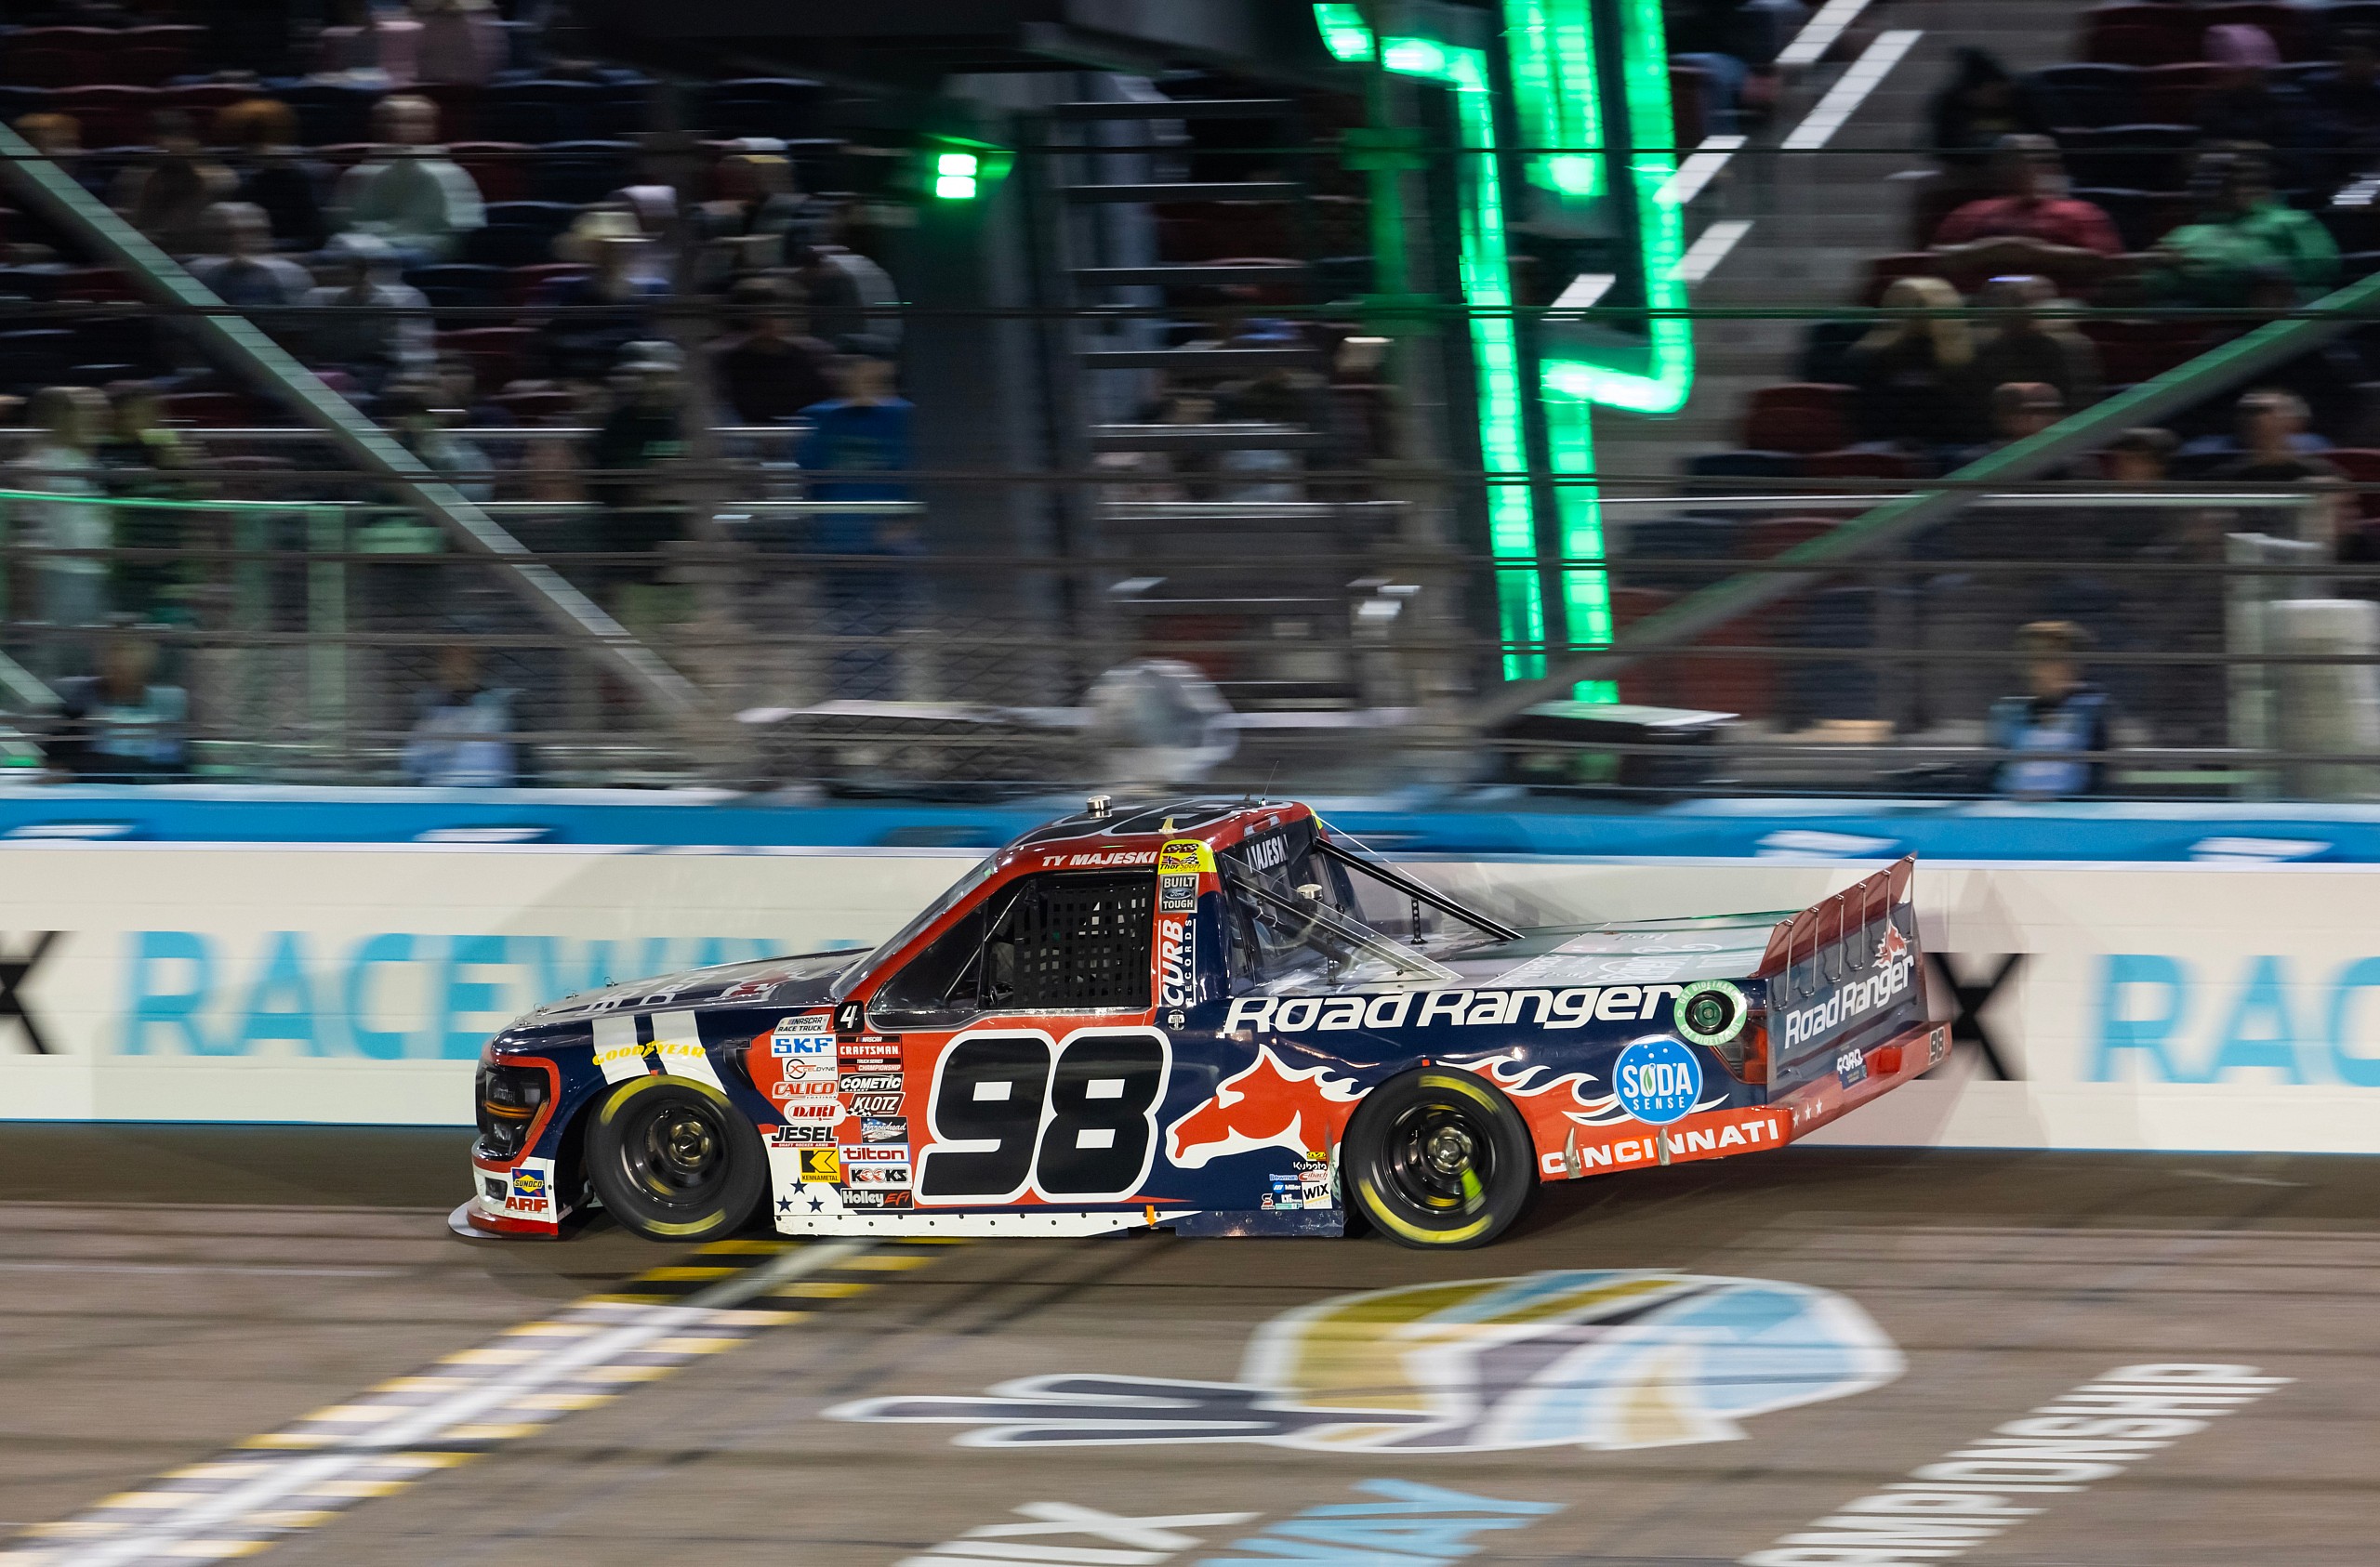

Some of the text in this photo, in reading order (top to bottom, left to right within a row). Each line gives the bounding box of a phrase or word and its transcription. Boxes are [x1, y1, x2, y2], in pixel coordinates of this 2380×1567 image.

[1042, 851, 1158, 867] TY MAJESKI
[1164, 876, 1196, 889] BUILT
[1163, 899, 1194, 910] TOUGH
[1162, 919, 1184, 1007] CURB
[1184, 919, 1193, 1007] RECORDS
[1223, 992, 1415, 1034] Road
[1416, 985, 1682, 1030] Ranger
[1784, 955, 1915, 1049] Road Ranger
[840, 1005, 858, 1029] 4
[592, 1040, 707, 1066] GOODYEAR
[774, 1037, 833, 1054] SKF
[840, 1046, 899, 1055] CRAFTSMAN
[774, 1082, 837, 1095] CALICO
[840, 1076, 902, 1090] COMETIC
[1622, 1063, 1694, 1099] SODA
[853, 1097, 899, 1111] KLOTZ
[1633, 1096, 1686, 1111] SENSE
[792, 1104, 840, 1121] DART
[914, 1025, 1173, 1205] 98
[771, 1126, 835, 1142] JESEL
[843, 1147, 905, 1160] tilton
[1292, 1161, 1328, 1170] Kubota
[514, 1179, 543, 1188] SUNOCO
[1303, 1183, 1329, 1200] WIX
[505, 1197, 549, 1212] ARP
[842, 1191, 883, 1207] Holley
